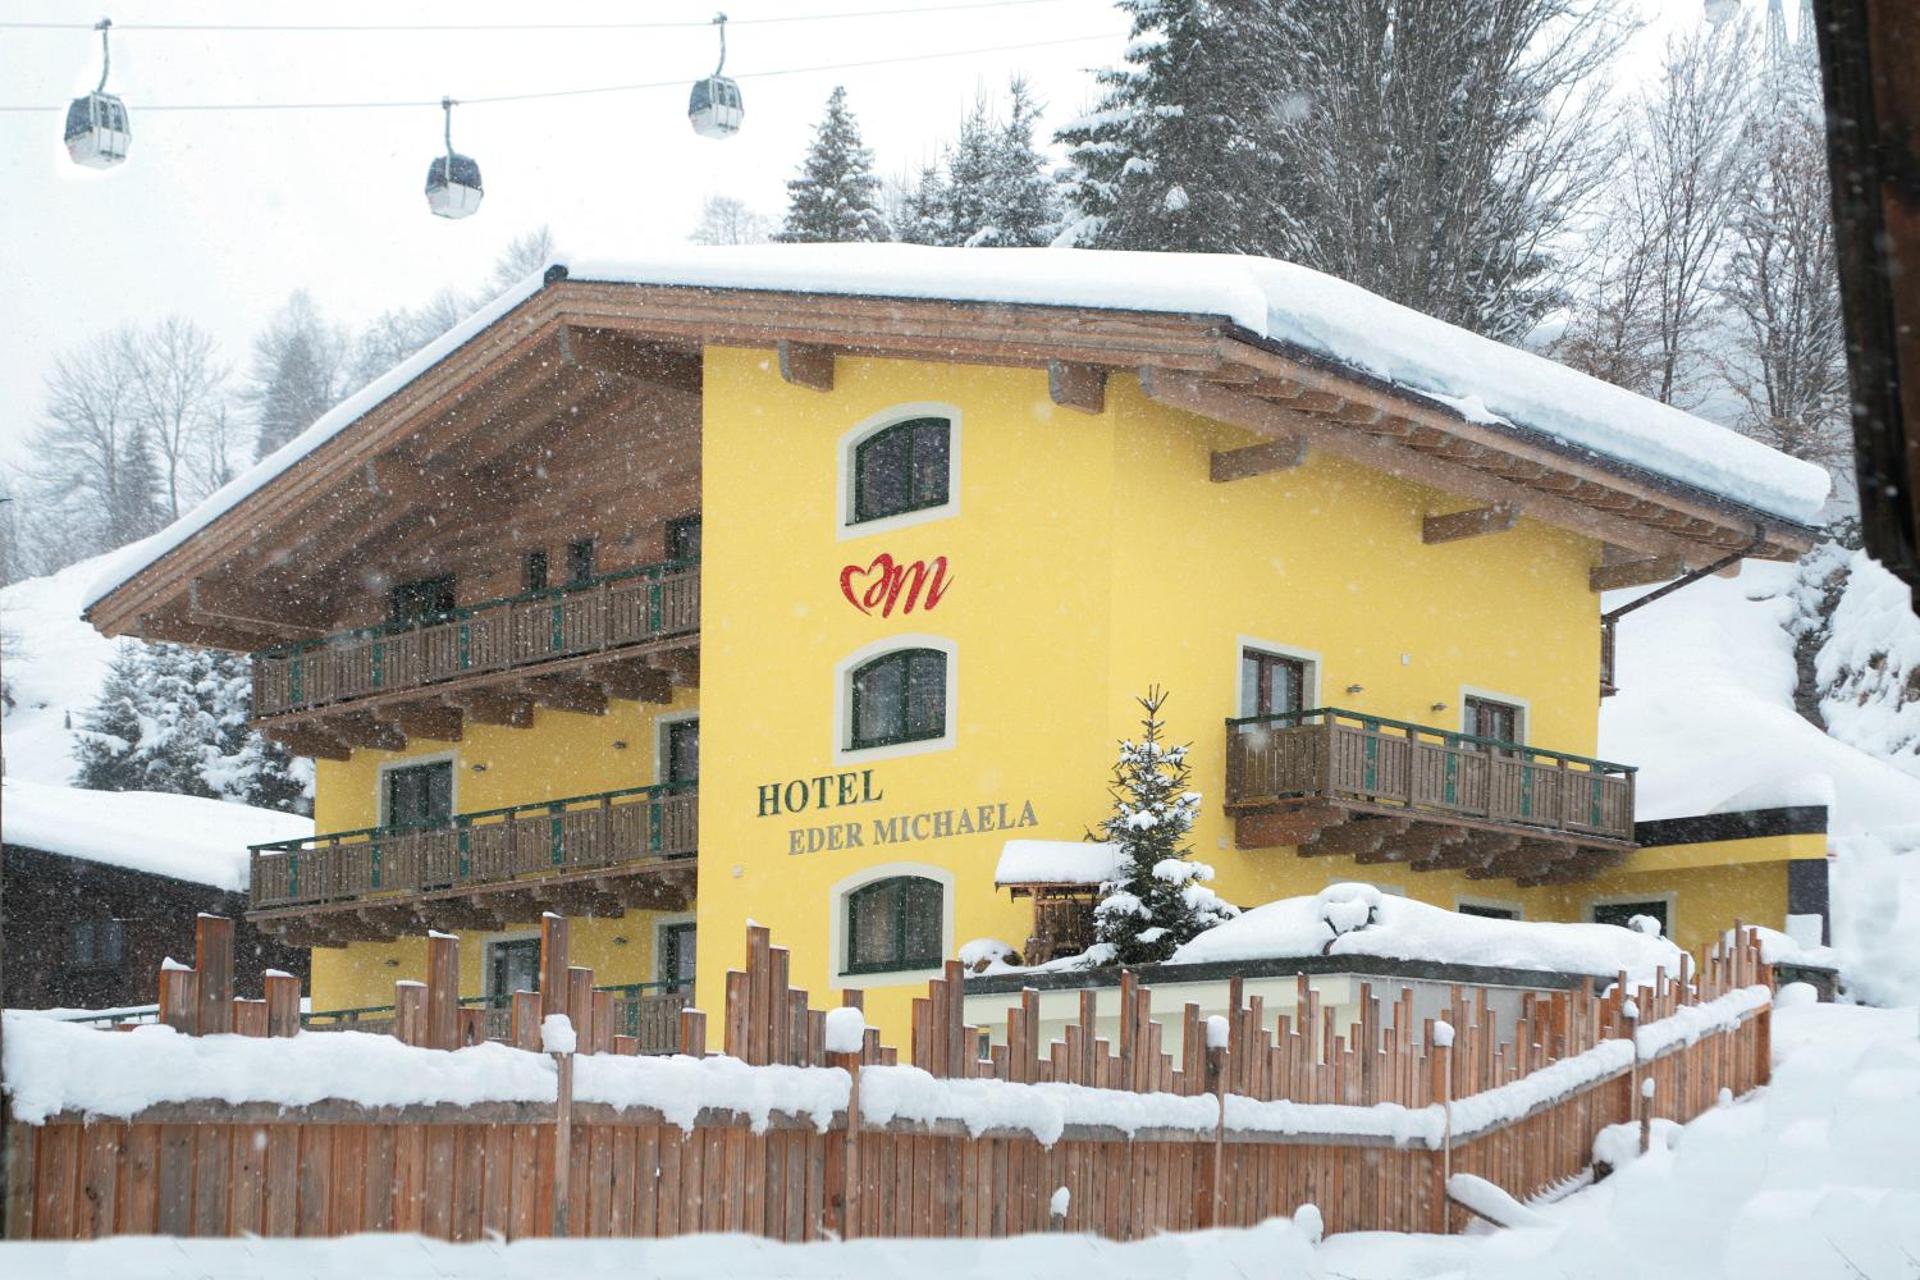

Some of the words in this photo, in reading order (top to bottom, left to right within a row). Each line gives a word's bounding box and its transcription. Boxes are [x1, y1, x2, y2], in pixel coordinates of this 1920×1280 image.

[757, 769, 884, 817] HOTEL
[788, 822, 864, 856] EDER
[873, 799, 1039, 845] MICHAELA
